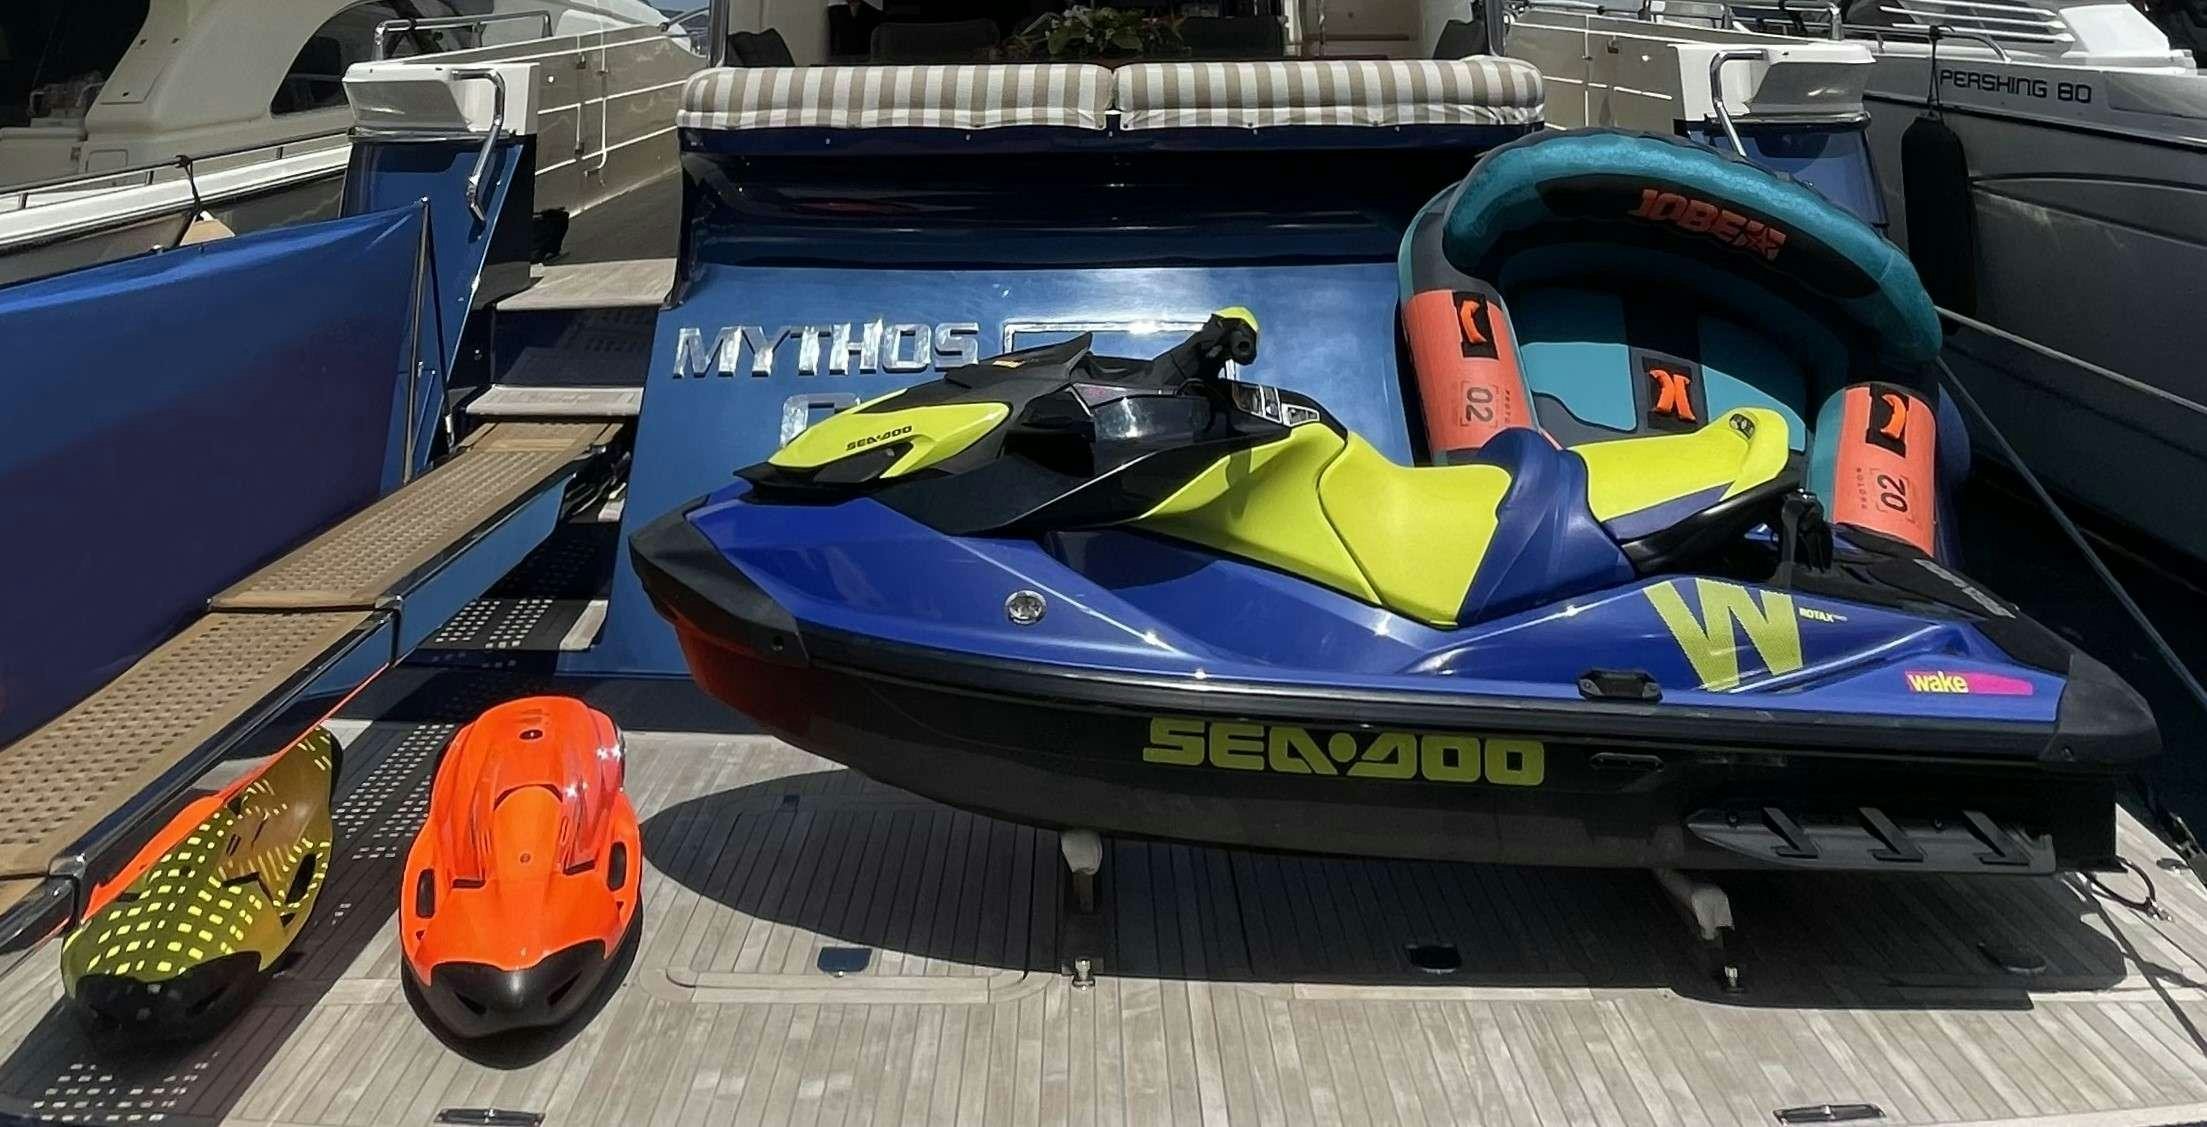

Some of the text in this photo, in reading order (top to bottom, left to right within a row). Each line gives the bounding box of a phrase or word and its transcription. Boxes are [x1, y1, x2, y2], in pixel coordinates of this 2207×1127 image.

[1939, 69, 2092, 104] PERSHING 80
[672, 319, 980, 379] MYTHOS
[1465, 386, 1494, 423] 02
[1877, 474, 1908, 513] 02
[1642, 577, 1803, 692] W
[1906, 670, 1969, 693] wake
